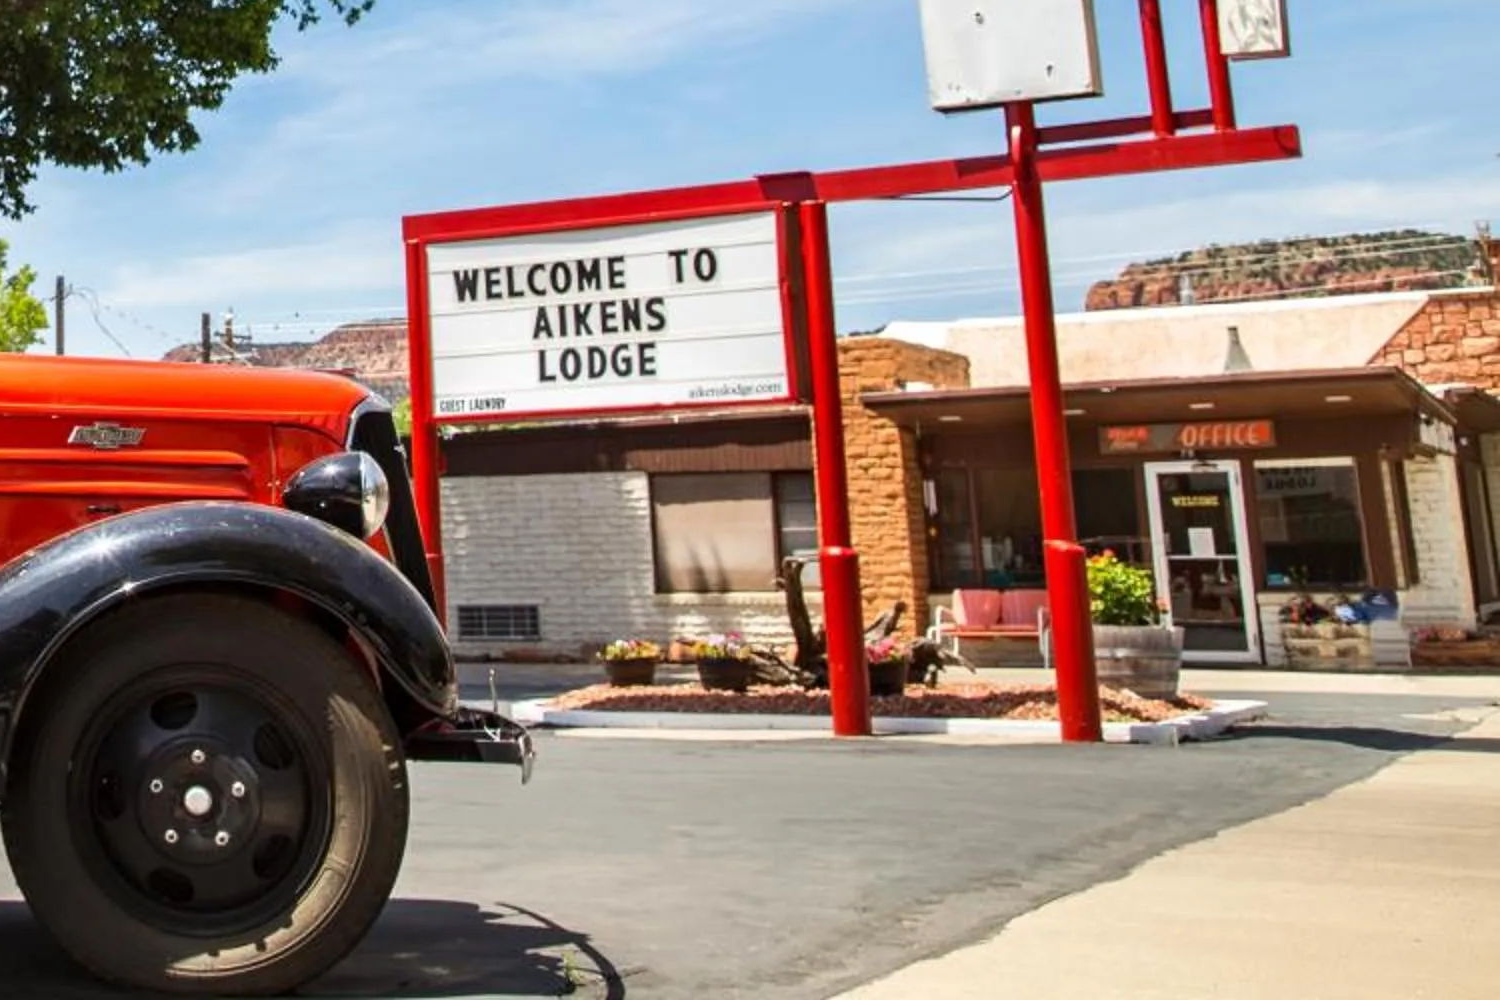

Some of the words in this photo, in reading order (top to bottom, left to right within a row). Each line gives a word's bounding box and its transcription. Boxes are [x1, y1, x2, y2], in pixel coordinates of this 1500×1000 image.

[453, 256, 626, 303] WELCOME
[668, 248, 717, 283] TO
[532, 298, 666, 339] AIKENS
[538, 342, 657, 382] LODGE
[439, 399, 465, 412] GUEST
[1181, 424, 1260, 447] OFFICE
